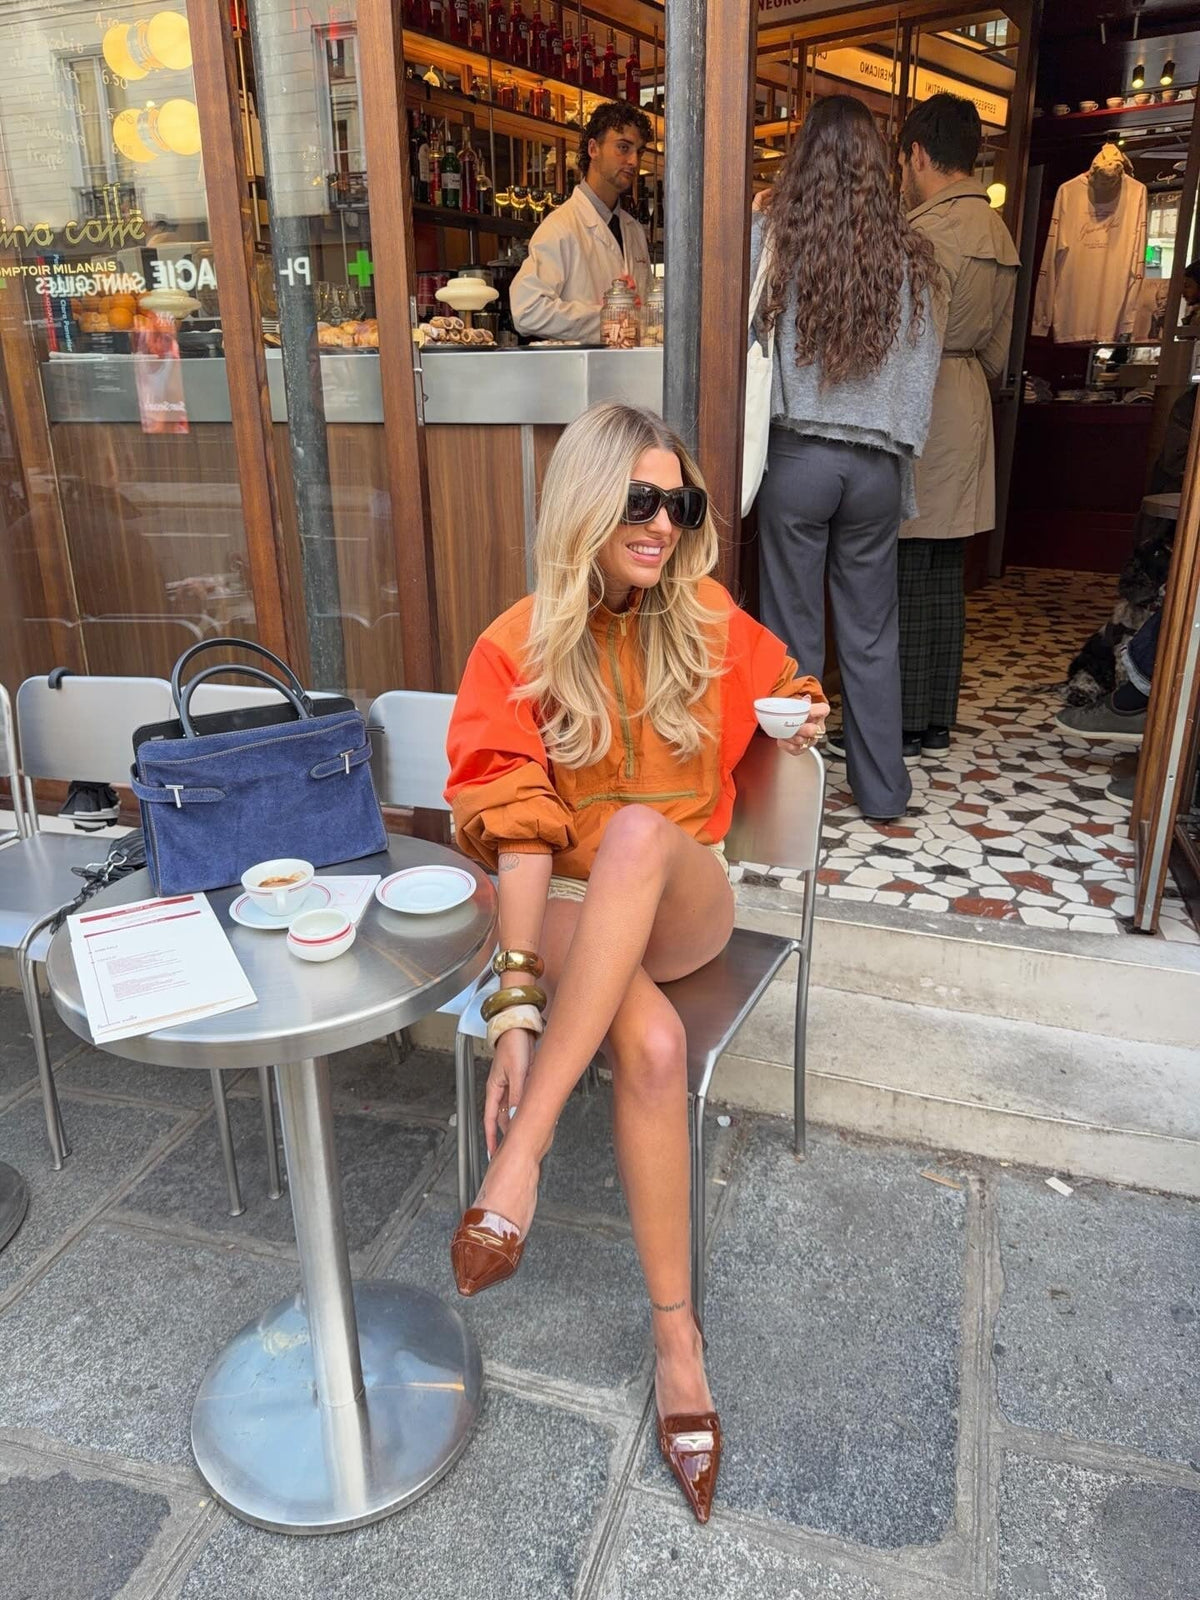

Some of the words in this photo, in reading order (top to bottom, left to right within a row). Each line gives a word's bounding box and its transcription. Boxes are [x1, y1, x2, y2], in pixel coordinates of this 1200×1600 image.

[102, 70, 128, 90] 6.50
[0, 265, 51, 278] MPTOIR
[53, 261, 117, 275] MILANAIS
